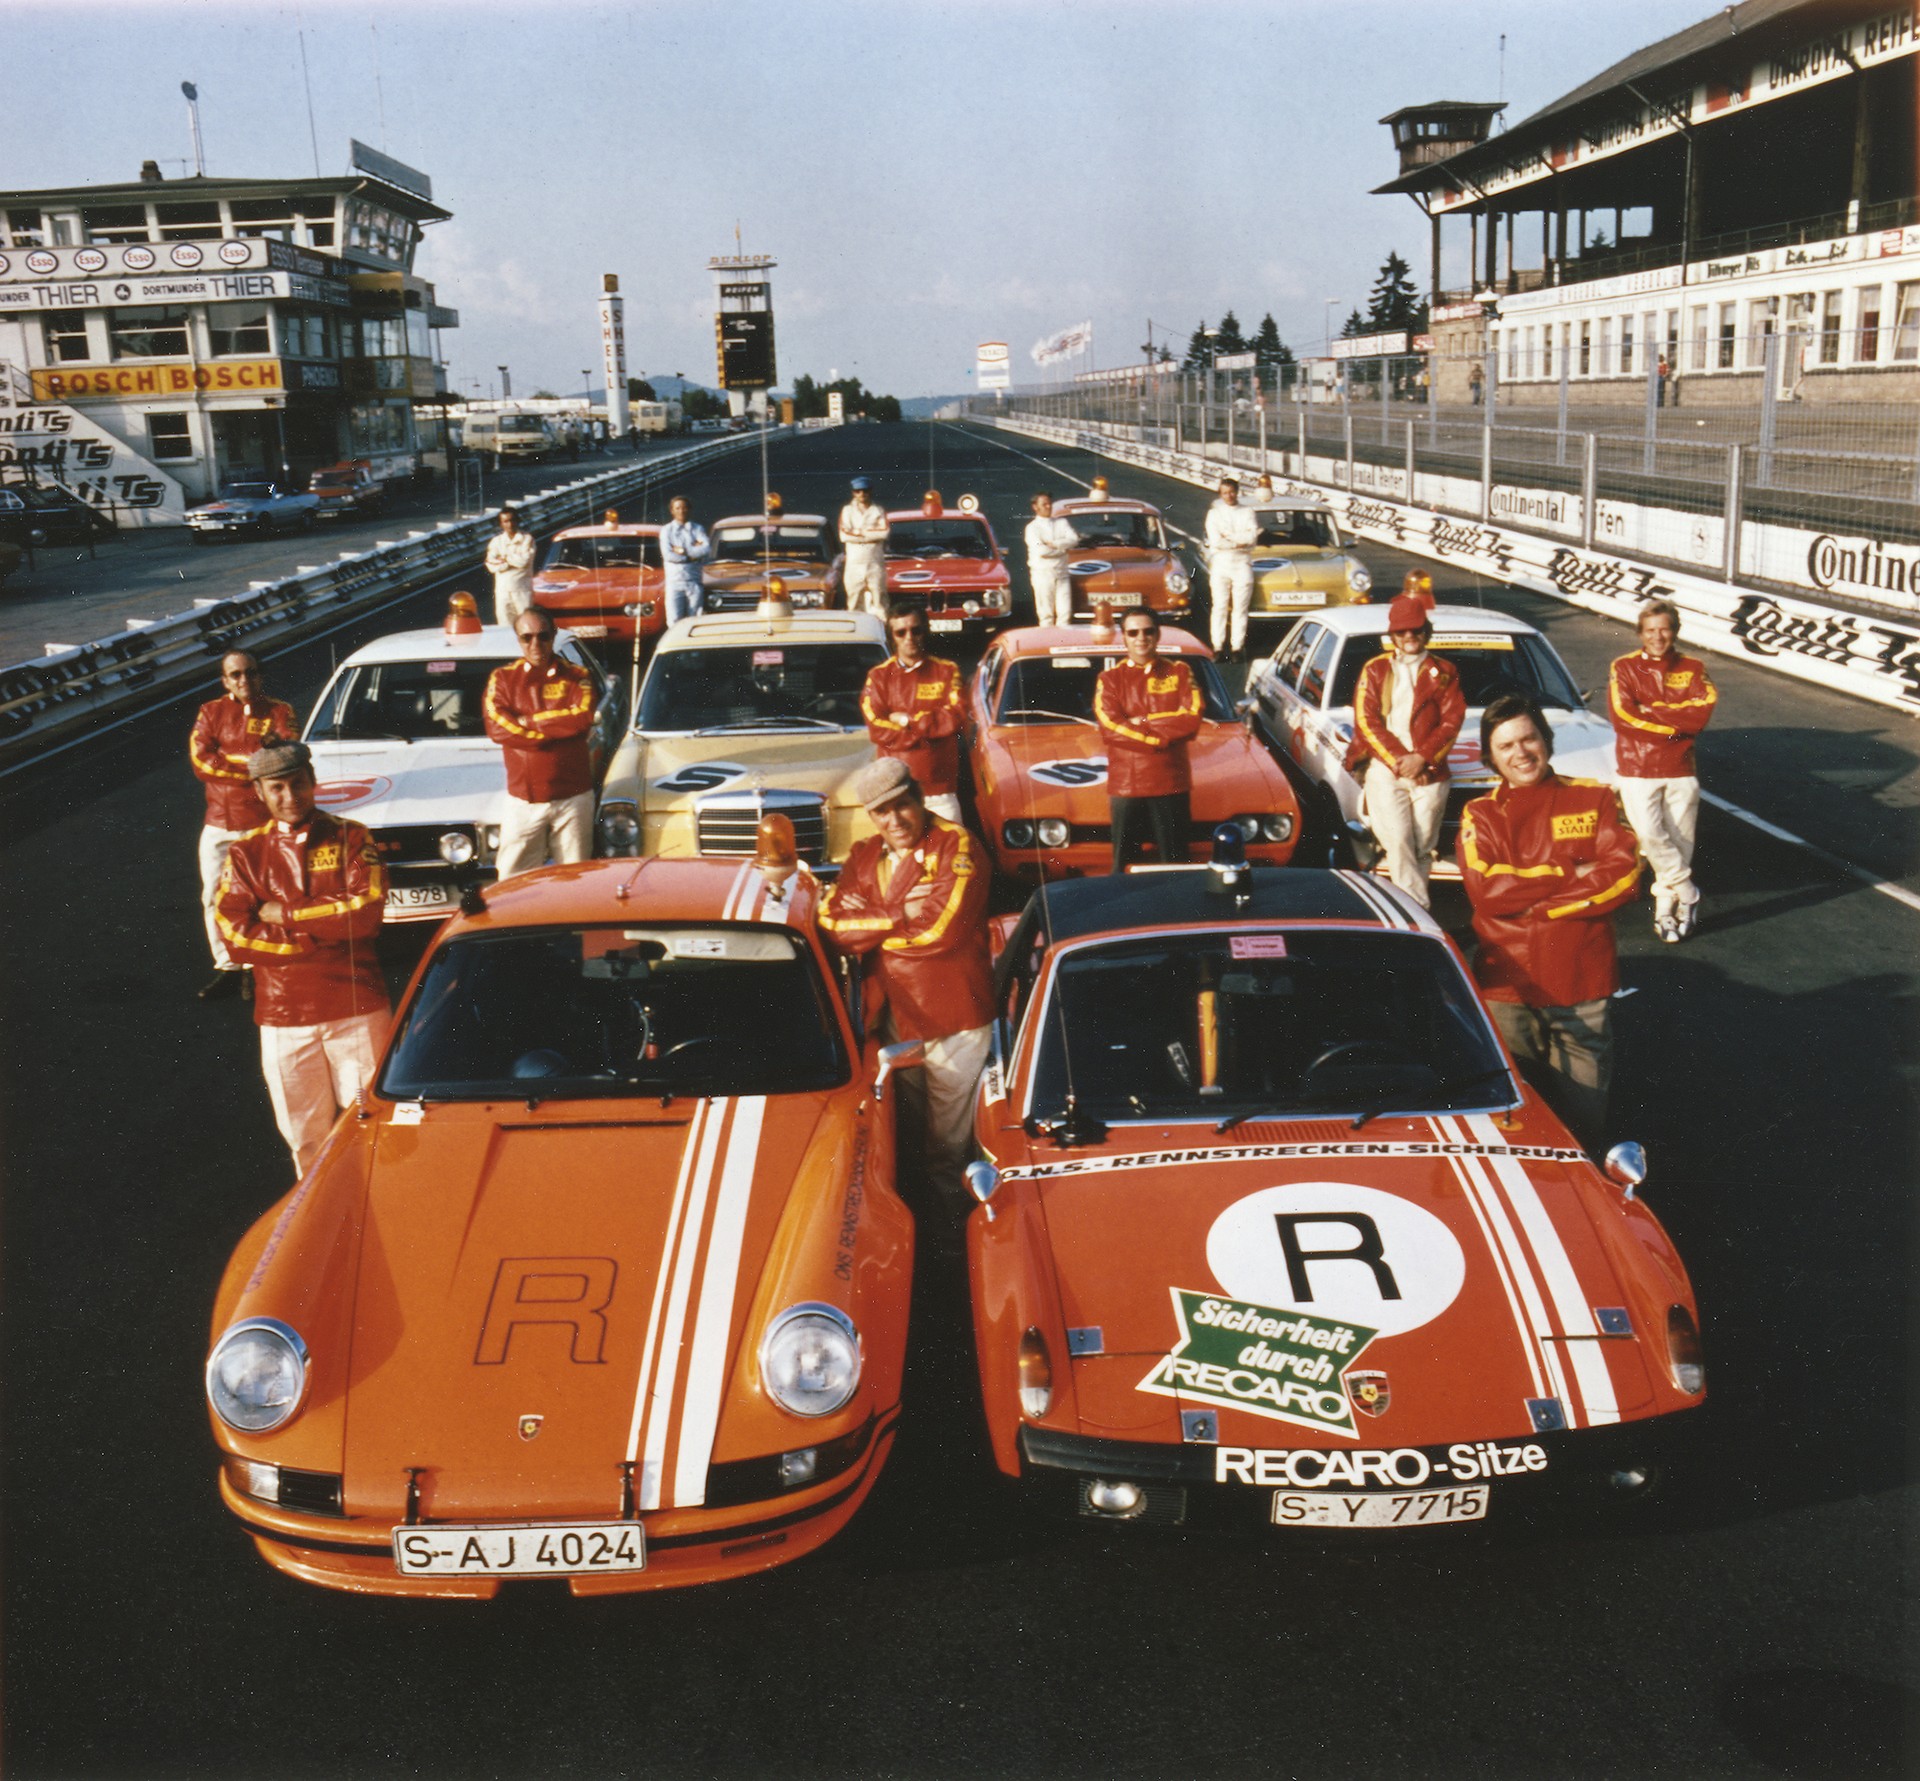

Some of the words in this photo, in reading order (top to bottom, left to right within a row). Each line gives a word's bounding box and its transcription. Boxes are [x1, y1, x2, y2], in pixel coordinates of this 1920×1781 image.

[31, 256, 54, 267] Esso
[79, 254, 102, 264] Esso
[127, 252, 150, 262] Esso
[175, 250, 198, 260] Esso
[223, 247, 246, 257] Esso
[32, 284, 100, 306] THIER
[142, 283, 207, 295] DORTMUNDER
[209, 275, 276, 297] THIER
[602, 310, 614, 389] SHELL
[612, 309, 627, 389] SHELL
[48, 370, 155, 394] BOSCH
[171, 365, 277, 389] BOSCH
[1490, 484, 1565, 523] Continental
[410, 887, 442, 905] 978
[1274, 1211, 1402, 1303] R
[473, 1256, 619, 1366] R
[1192, 1300, 1356, 1355] Sicherheit
[1237, 1341, 1335, 1384] durch
[1162, 1357, 1351, 1421] RECARO
[1216, 1443, 1548, 1487] RECARO-Sitze
[1391, 1489, 1482, 1523] 7715
[535, 1530, 637, 1567] 4024
